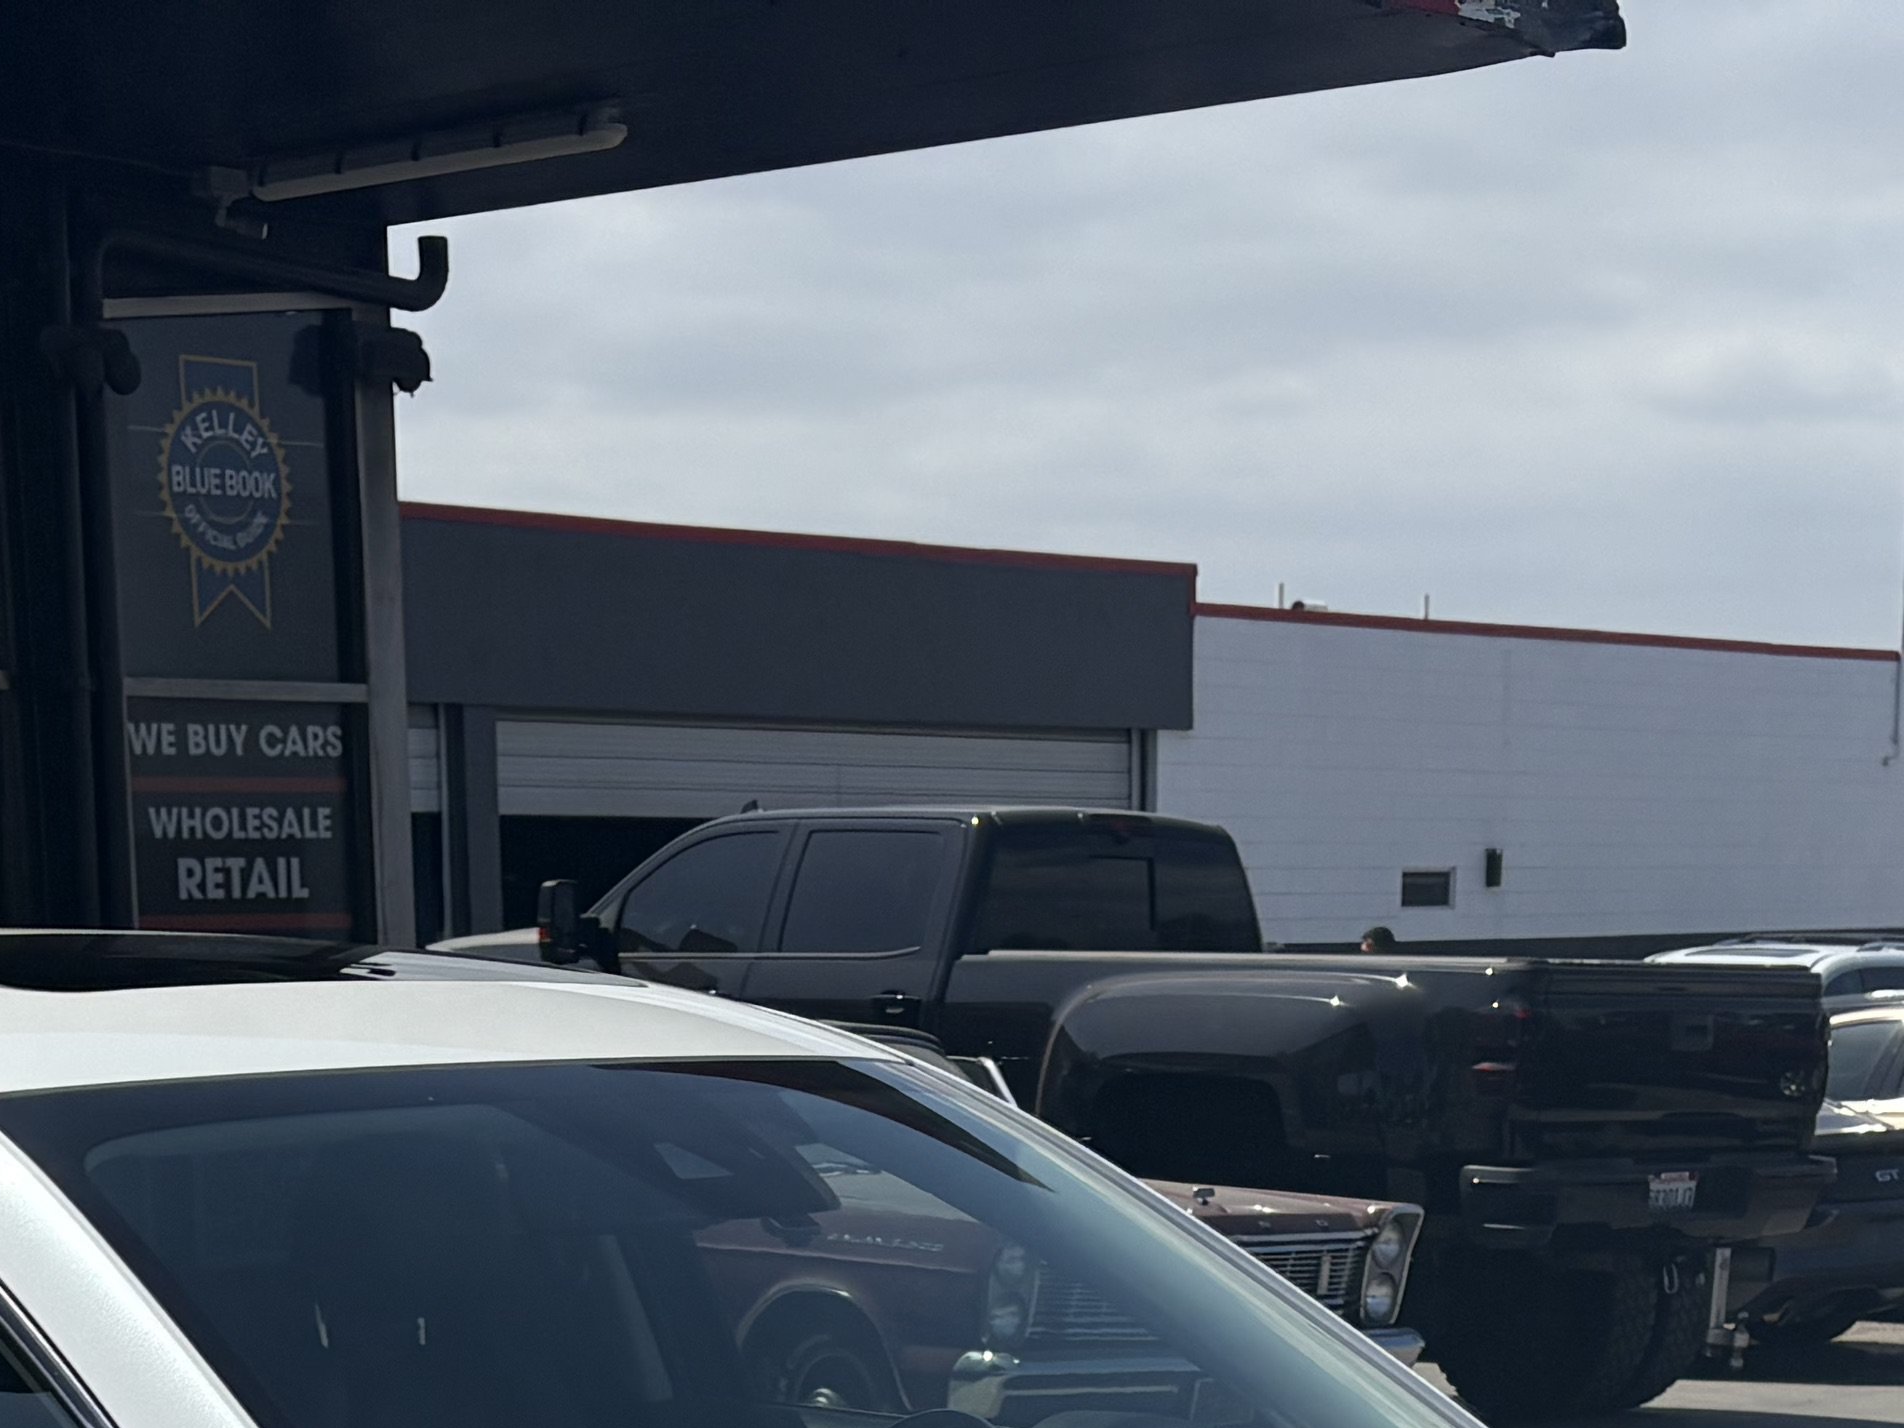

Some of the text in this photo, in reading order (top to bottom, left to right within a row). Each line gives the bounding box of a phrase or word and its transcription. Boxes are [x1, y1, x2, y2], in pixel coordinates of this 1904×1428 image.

[180, 409, 269, 458] KELLEY
[171, 464, 277, 499] BLUE BOOK
[128, 721, 343, 758] WE BUY CARS
[148, 806, 333, 841] WHOLESALE
[176, 856, 310, 901] RETAIL
[1875, 1168, 1899, 1182] GT
